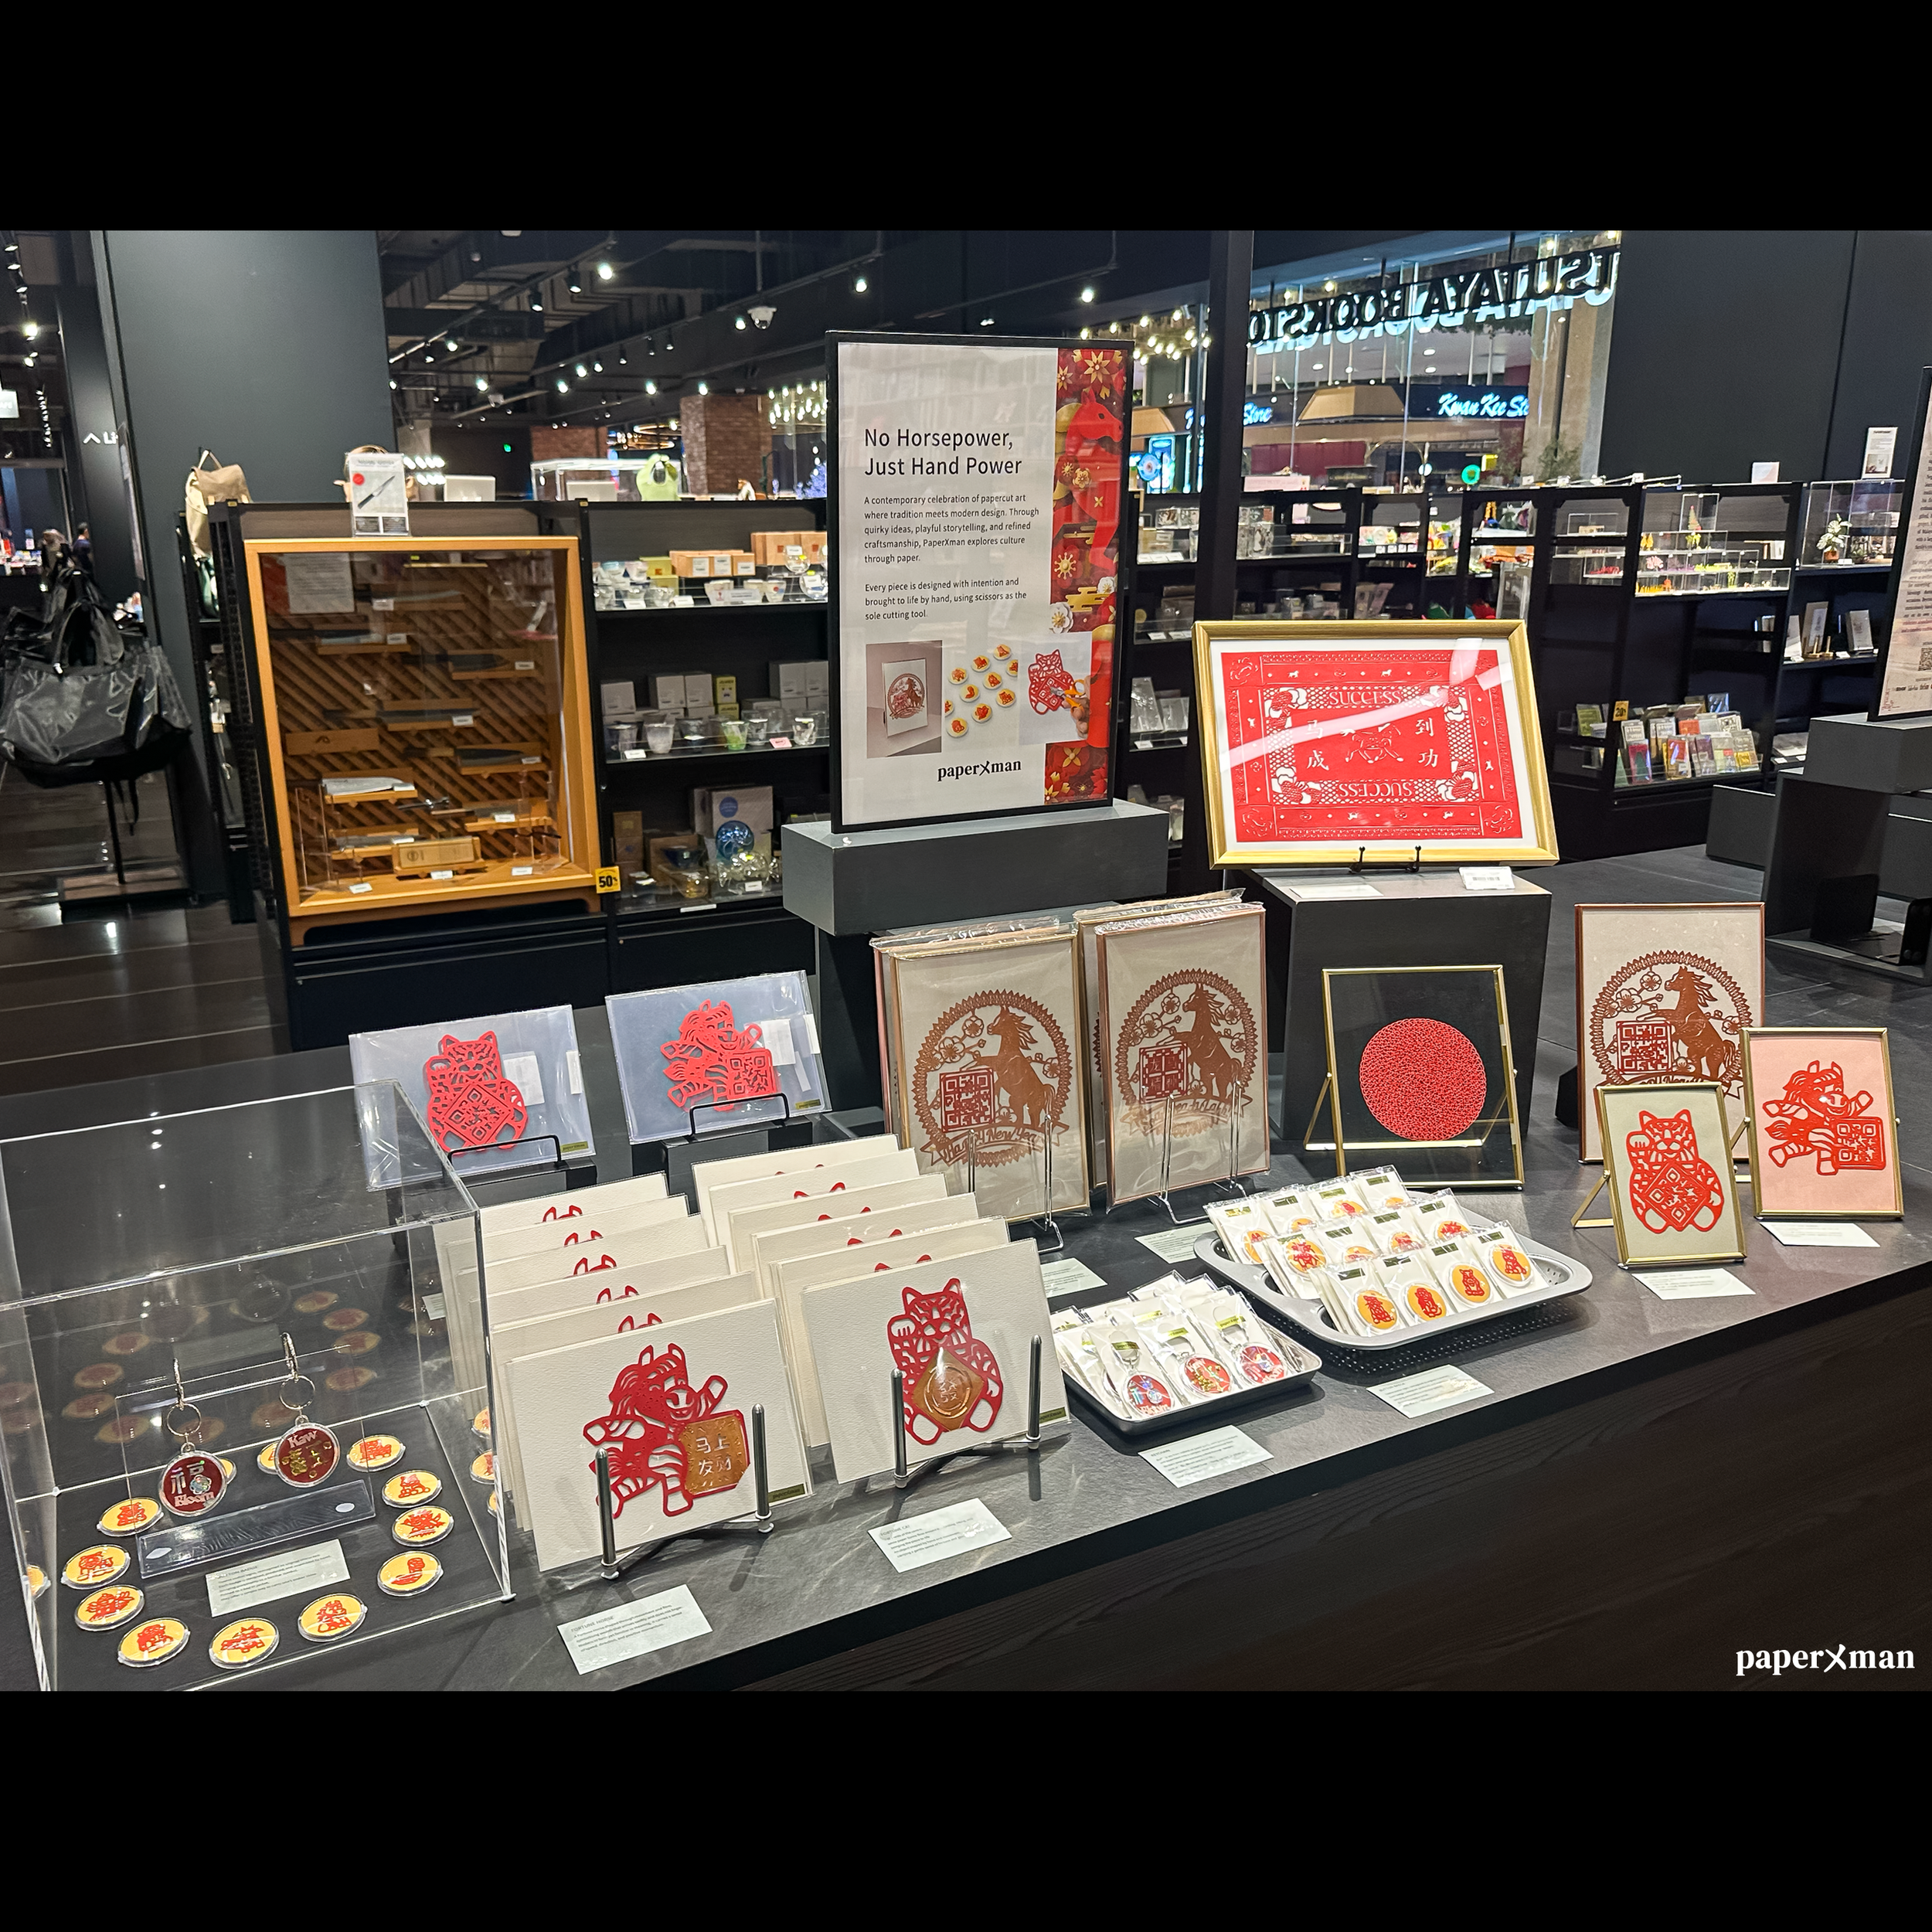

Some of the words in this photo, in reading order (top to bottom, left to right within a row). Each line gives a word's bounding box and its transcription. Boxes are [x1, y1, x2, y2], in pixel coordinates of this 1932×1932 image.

[1480, 393, 1507, 417] Kee
[866, 429, 889, 447] No
[898, 429, 1013, 451] Horsepower,
[865, 457, 905, 475] Just
[913, 456, 958, 475] Hand
[968, 457, 1022, 474] Power
[872, 497, 925, 505] contemporary
[981, 495, 1013, 504] papercut
[865, 511, 888, 519] where
[981, 509, 1007, 518] design.
[1009, 508, 1039, 517] Through
[865, 525, 889, 535] quirky
[891, 525, 913, 534] ideas,
[915, 524, 941, 534] playful
[944, 524, 988, 532] storytelling,
[1005, 522, 1031, 530] refined
[865, 539, 921, 549] craftsmanship,
[923, 539, 965, 549] PaperXman
[968, 537, 998, 546] explores
[865, 554, 895, 564] through
[897, 555, 920, 563] paper.
[866, 583, 886, 593] Every
[889, 583, 908, 592] piece
[918, 581, 951, 590] designed
[971, 579, 1004, 587] intention
[866, 597, 895, 607] brought
[907, 596, 918, 604] life
[921, 595, 929, 604] by
[931, 595, 951, 604] hand,
[954, 594, 973, 603] using
[883, 611, 909, 620] cutting
[911, 610, 927, 618] tool.
[1329, 689, 1401, 705] SUCCESS
[1306, 719, 1323, 739] 马
[1415, 717, 1434, 736] 到
[1307, 750, 1329, 770] 成
[1418, 749, 1438, 767] 功
[1338, 782, 1413, 798] SUCCESS
[986, 1128, 1015, 1142] New
[696, 1433, 730, 1453] 马上
[174, 1492, 215, 1507] Bloom
